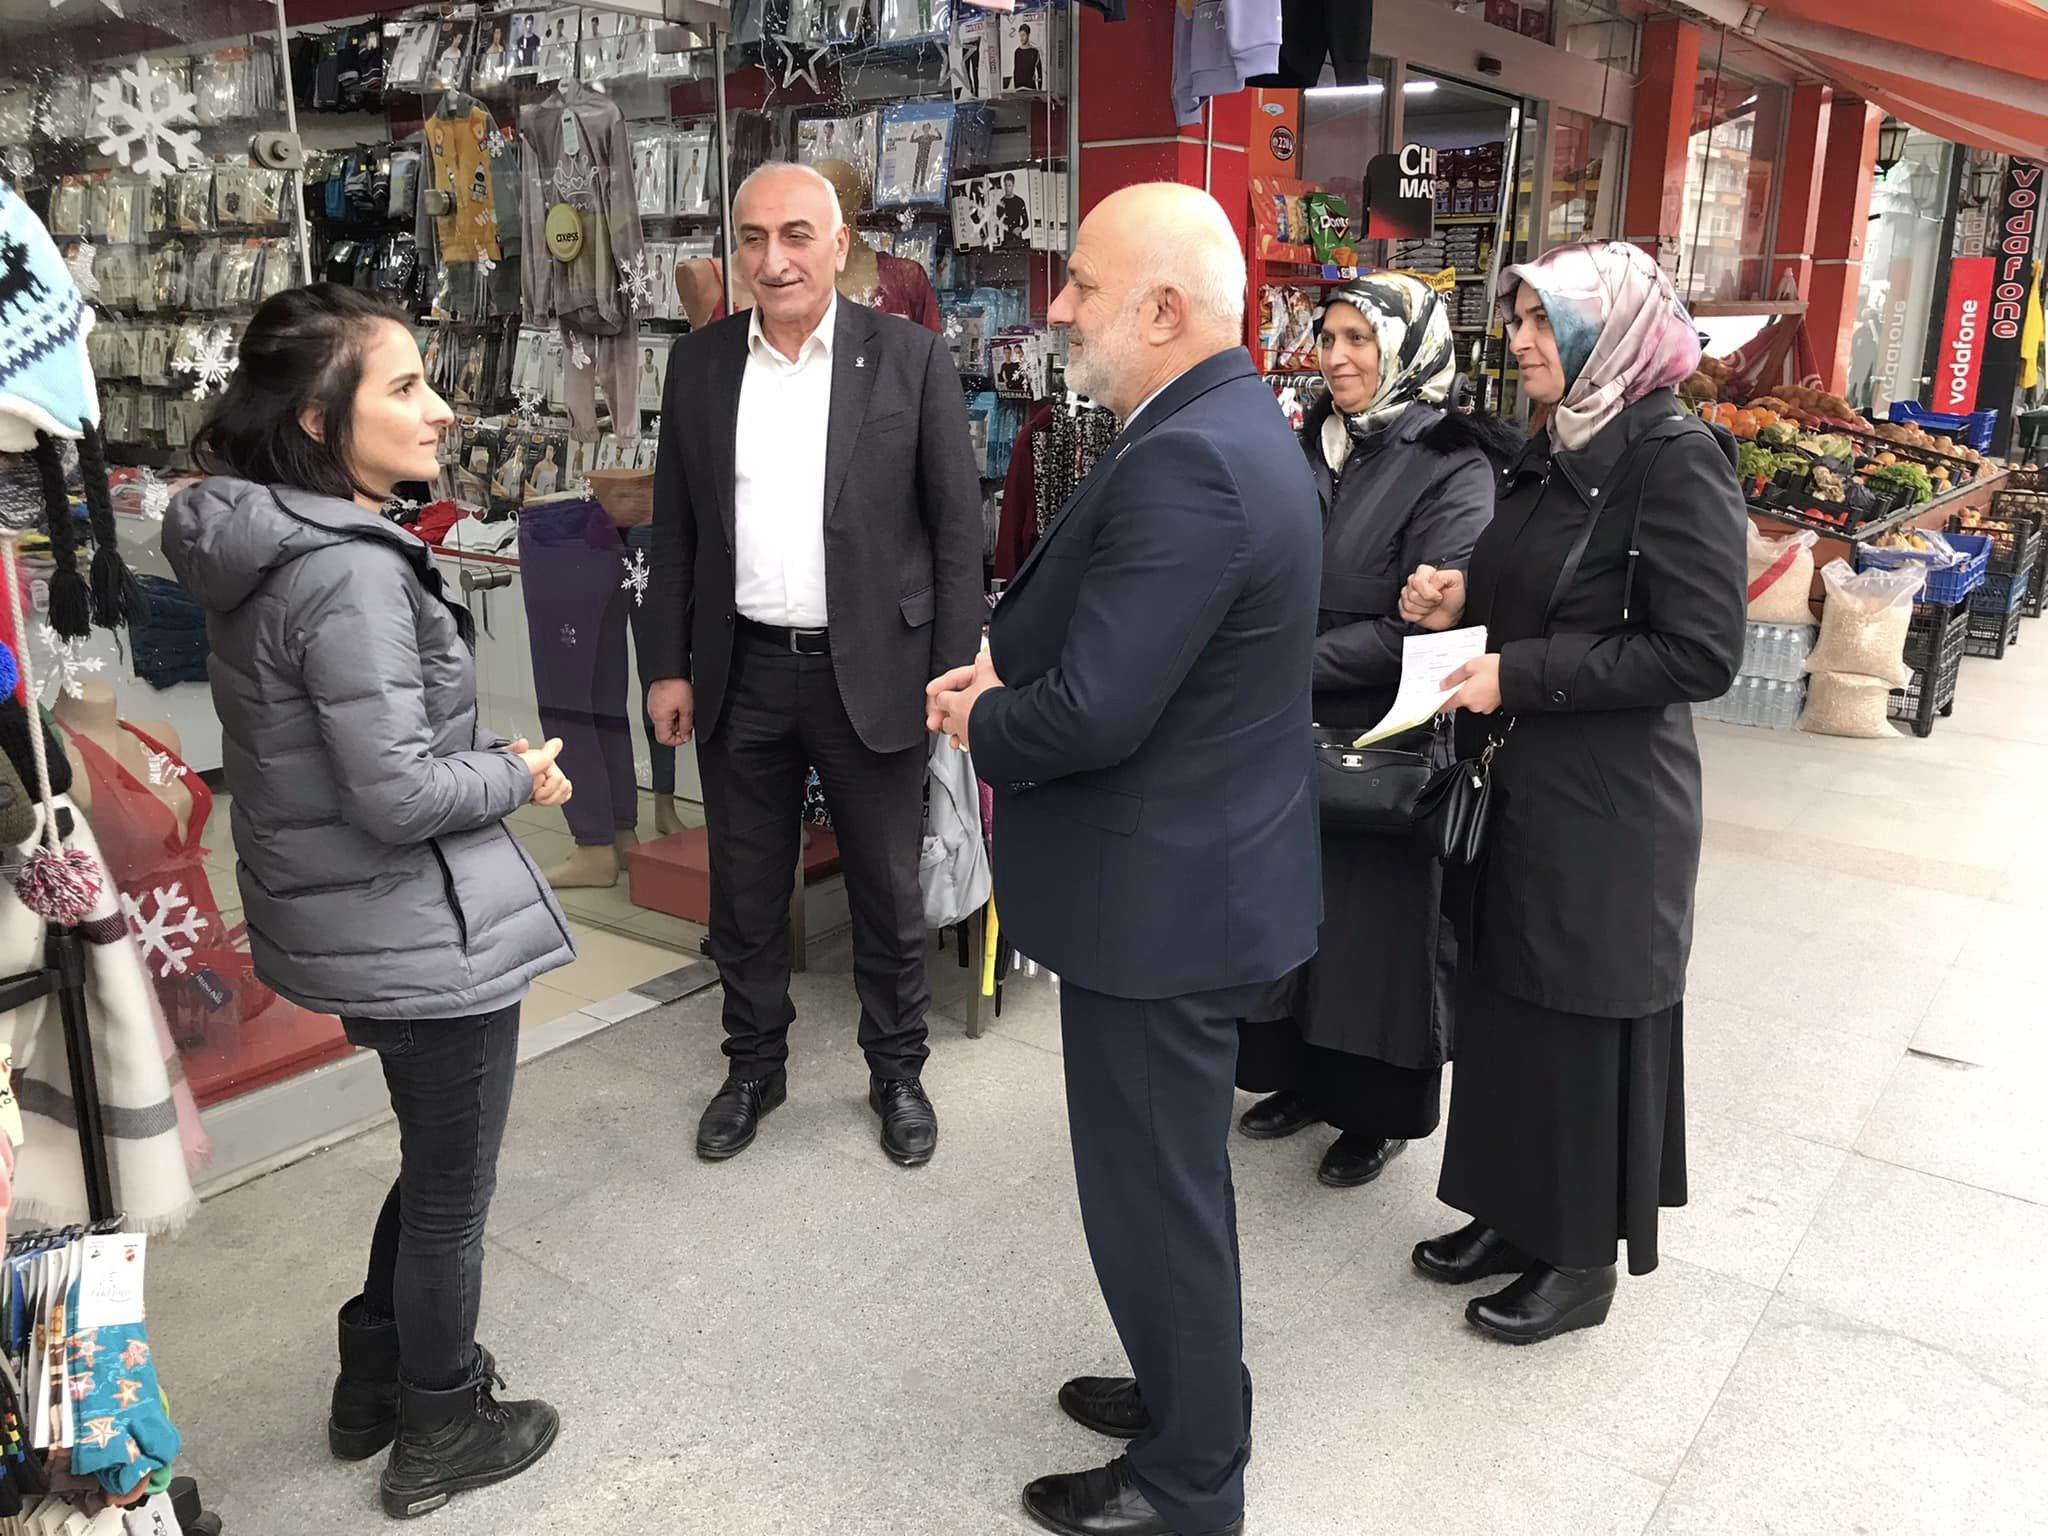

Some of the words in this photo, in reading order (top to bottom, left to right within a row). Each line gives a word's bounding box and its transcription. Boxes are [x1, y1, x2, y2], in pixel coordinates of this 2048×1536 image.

[555, 231, 579, 243] axess
[1992, 170, 2041, 339] vodafone
[1950, 299, 1978, 405] vodafone
[998, 391, 1033, 400] THERMAL
